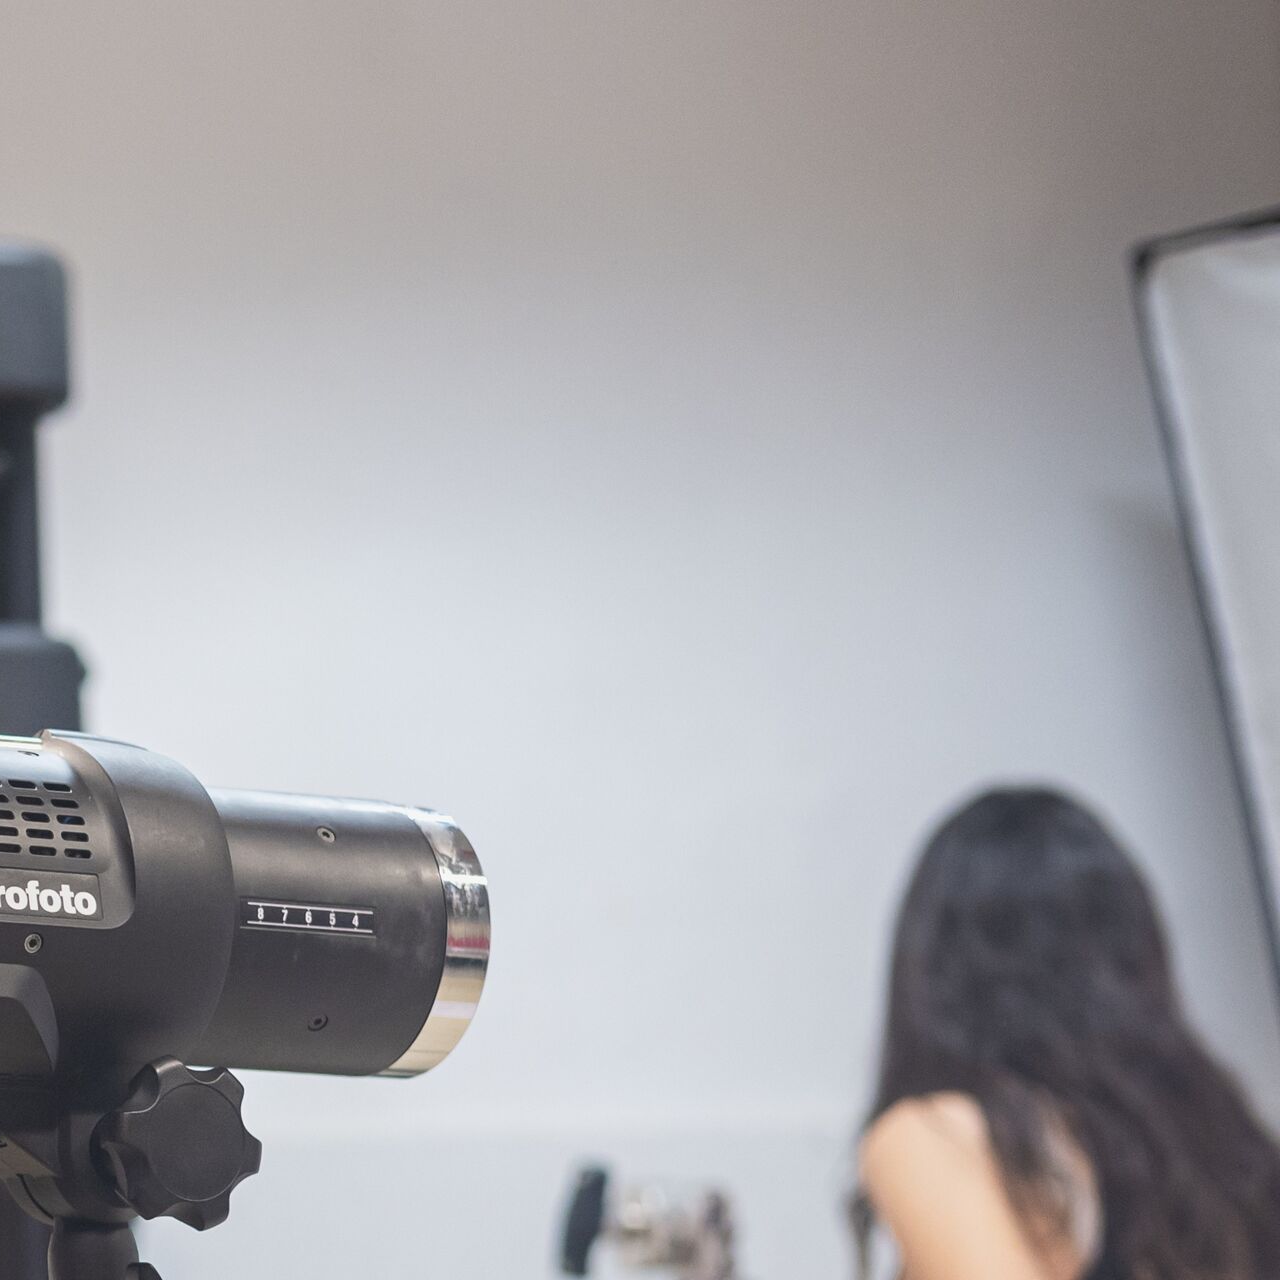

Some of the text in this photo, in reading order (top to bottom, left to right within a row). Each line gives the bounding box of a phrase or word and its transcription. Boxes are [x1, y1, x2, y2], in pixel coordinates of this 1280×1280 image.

[257, 907, 359, 927] 8 7 6 5 4
